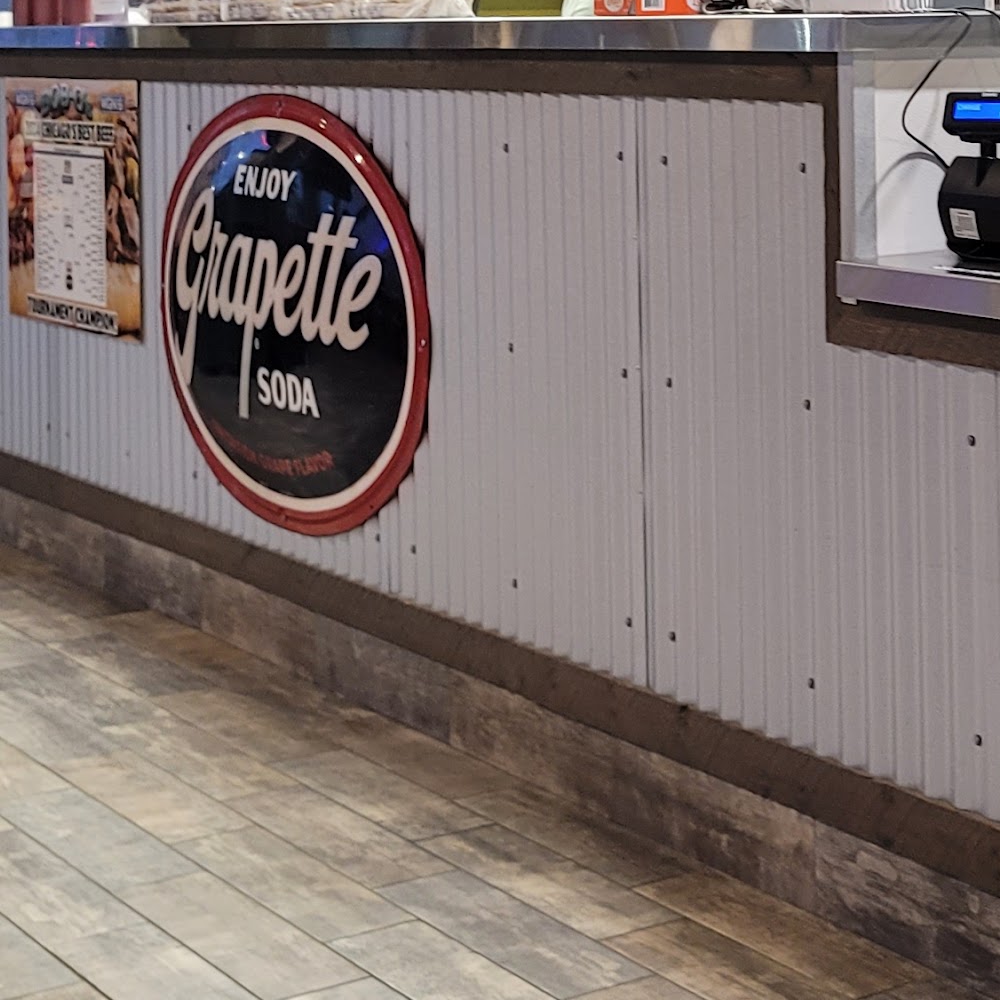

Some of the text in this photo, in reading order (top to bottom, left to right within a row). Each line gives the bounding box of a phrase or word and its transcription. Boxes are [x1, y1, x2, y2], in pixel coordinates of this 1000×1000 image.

[233, 164, 298, 201] ENJOY
[174, 187, 383, 420] Grapette
[256, 366, 321, 419] SODA
